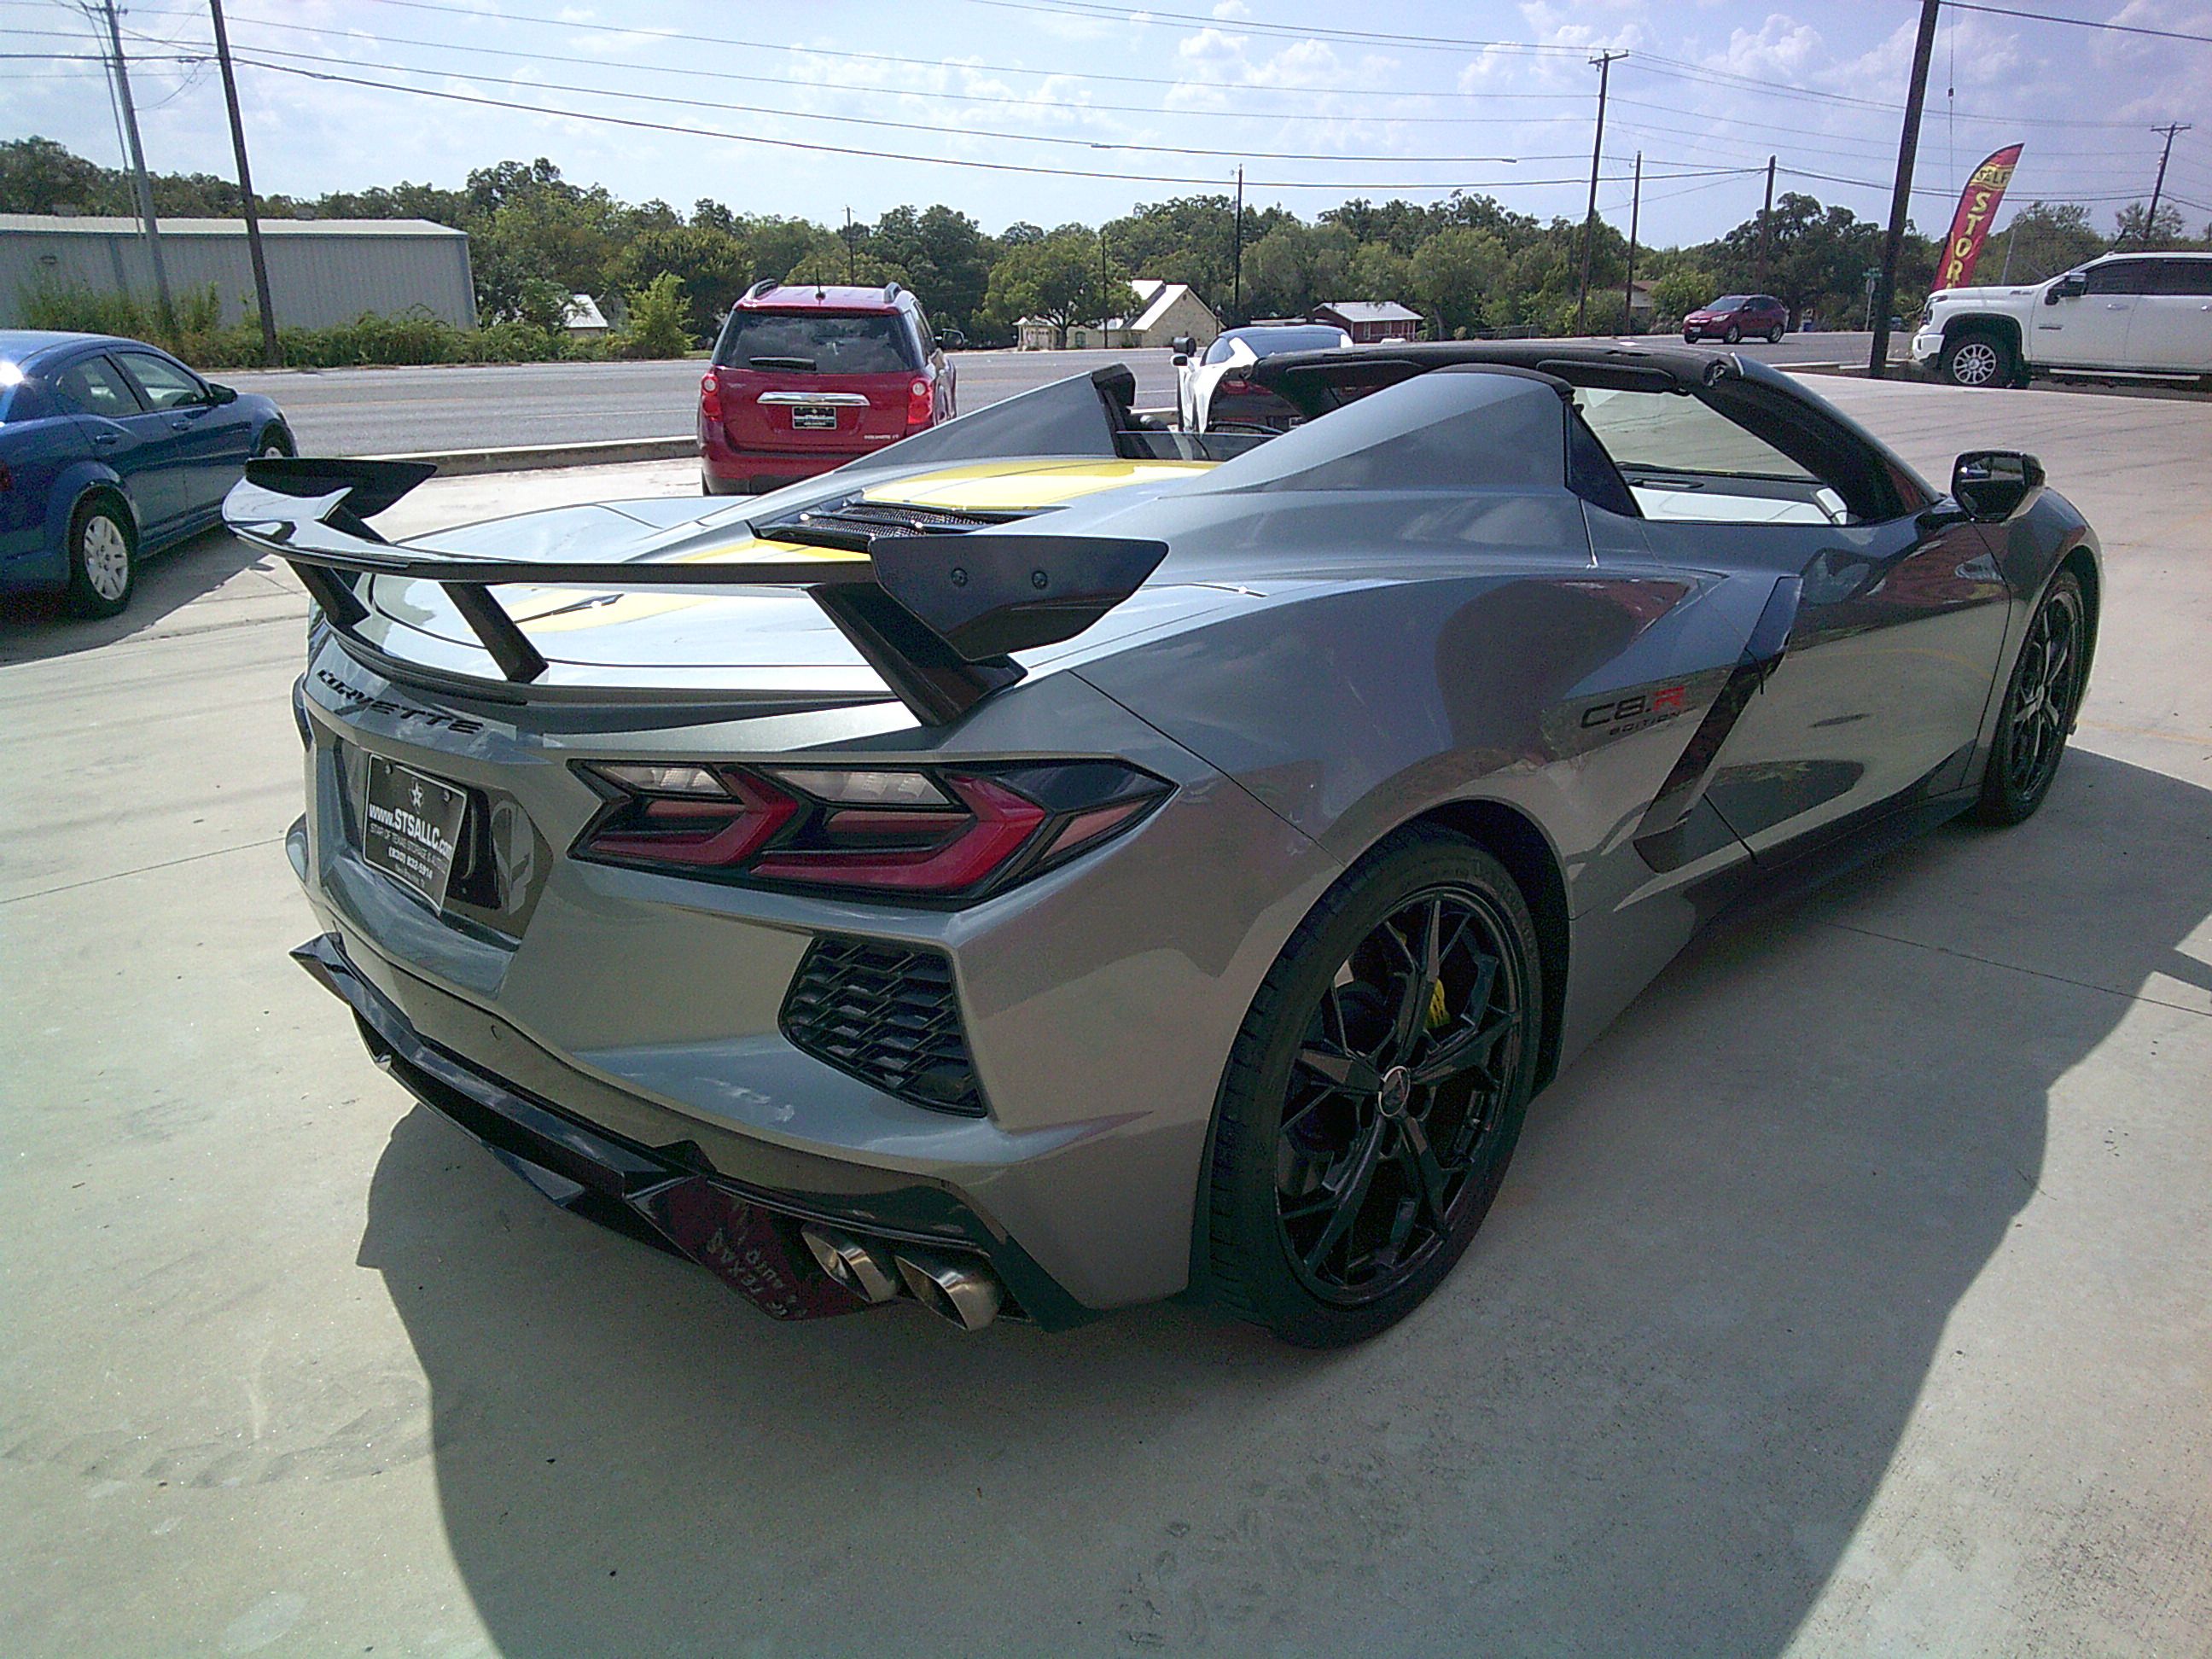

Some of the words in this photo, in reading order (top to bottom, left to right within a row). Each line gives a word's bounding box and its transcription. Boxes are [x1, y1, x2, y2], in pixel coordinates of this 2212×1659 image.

[1976, 168, 2011, 184] SELF
[1946, 191, 1991, 289] STOR
[317, 669, 484, 734] CORVETTE
[1580, 685, 1685, 728] C8.R
[369, 803, 453, 861] www.STSALLC.com
